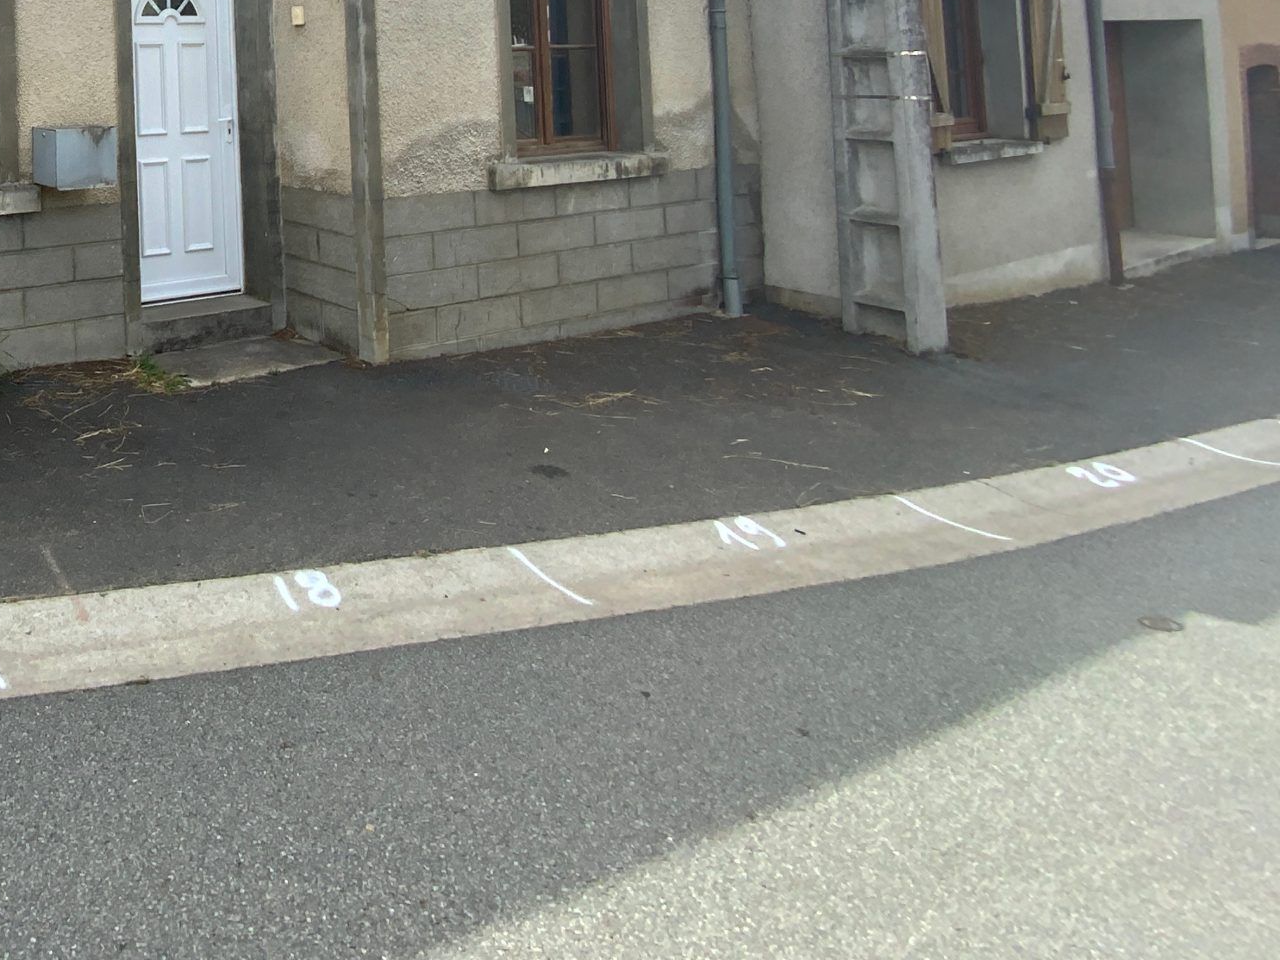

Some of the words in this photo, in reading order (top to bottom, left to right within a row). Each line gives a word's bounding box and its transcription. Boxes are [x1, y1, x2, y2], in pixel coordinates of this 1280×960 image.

[1065, 461, 1136, 487] 20
[713, 515, 787, 550] 19
[273, 568, 342, 612] 18
